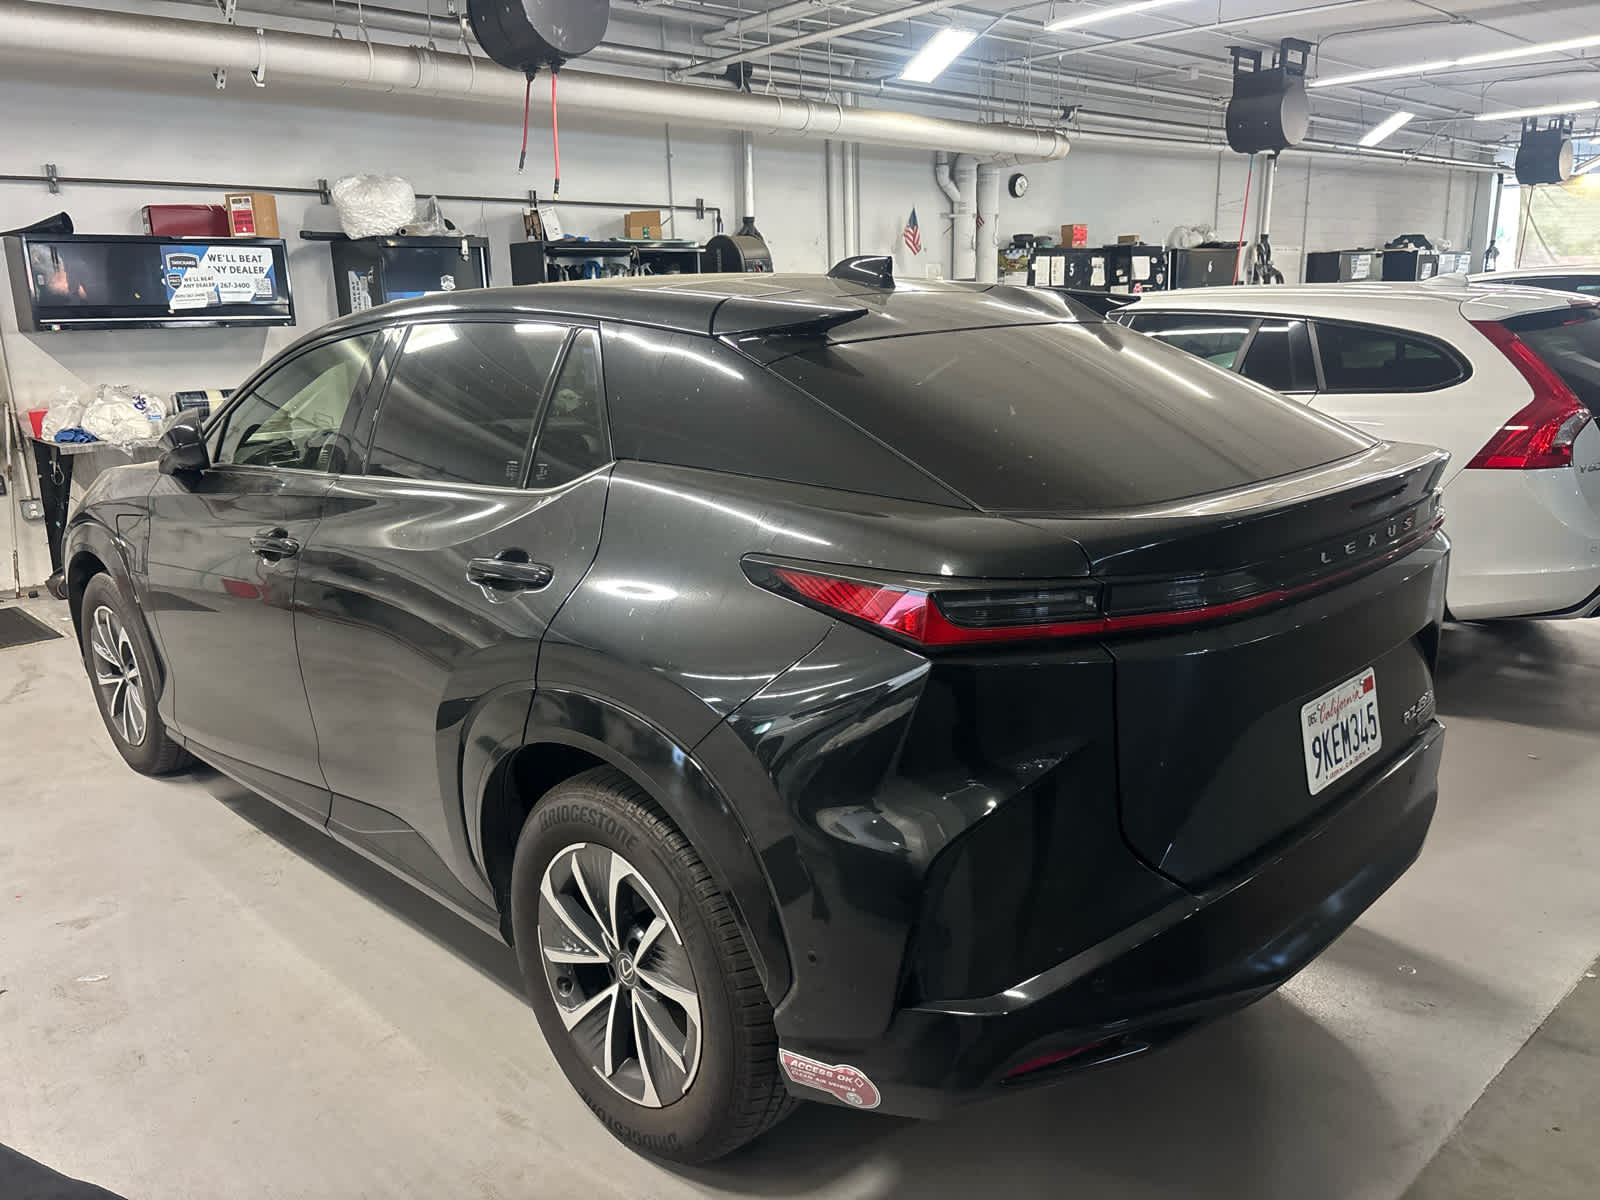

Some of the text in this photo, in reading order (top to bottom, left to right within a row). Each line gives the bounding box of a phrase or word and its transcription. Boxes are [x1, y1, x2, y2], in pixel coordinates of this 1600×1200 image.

[207, 254, 262, 263] WE'LL BEAT
[229, 265, 265, 274] DEALER
[1069, 263, 1075, 277] 5
[1320, 516, 1412, 564] LEXUS
[1320, 688, 1364, 724] California
[1311, 701, 1377, 779] 9KEM345
[539, 804, 639, 852] BRIDGESTONE
[790, 1059, 833, 1077] ACCESS
[837, 1074, 853, 1084] OK
